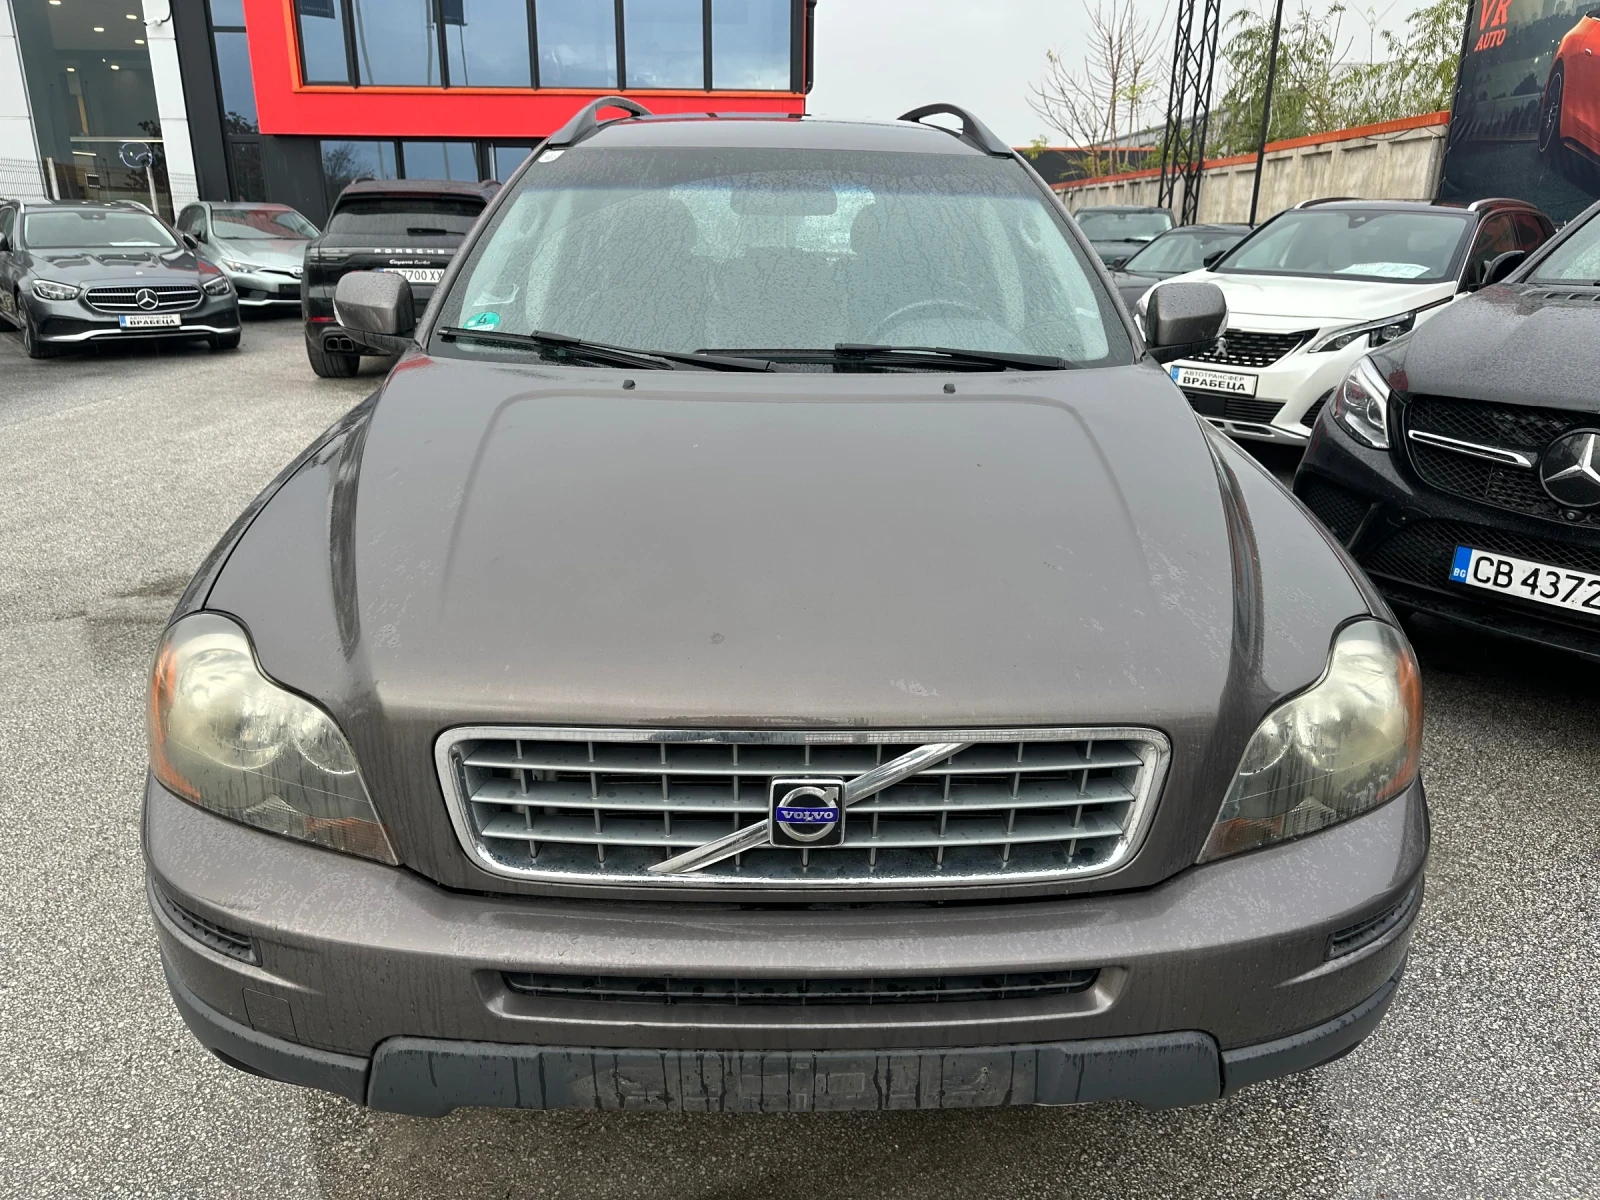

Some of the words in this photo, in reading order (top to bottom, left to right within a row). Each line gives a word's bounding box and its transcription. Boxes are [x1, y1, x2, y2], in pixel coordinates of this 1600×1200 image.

[1479, 0, 1512, 31] VR
[1474, 28, 1507, 52] AUTO
[477, 313, 487, 324] 4
[1184, 370, 1245, 382] АВТОТРАНСФЕР
[1182, 376, 1246, 392] ВРАБЕЦА
[1453, 567, 1466, 578] BG
[1473, 556, 1514, 588] CB
[1520, 567, 1600, 610] 4372
[781, 810, 834, 820] VOLVO
